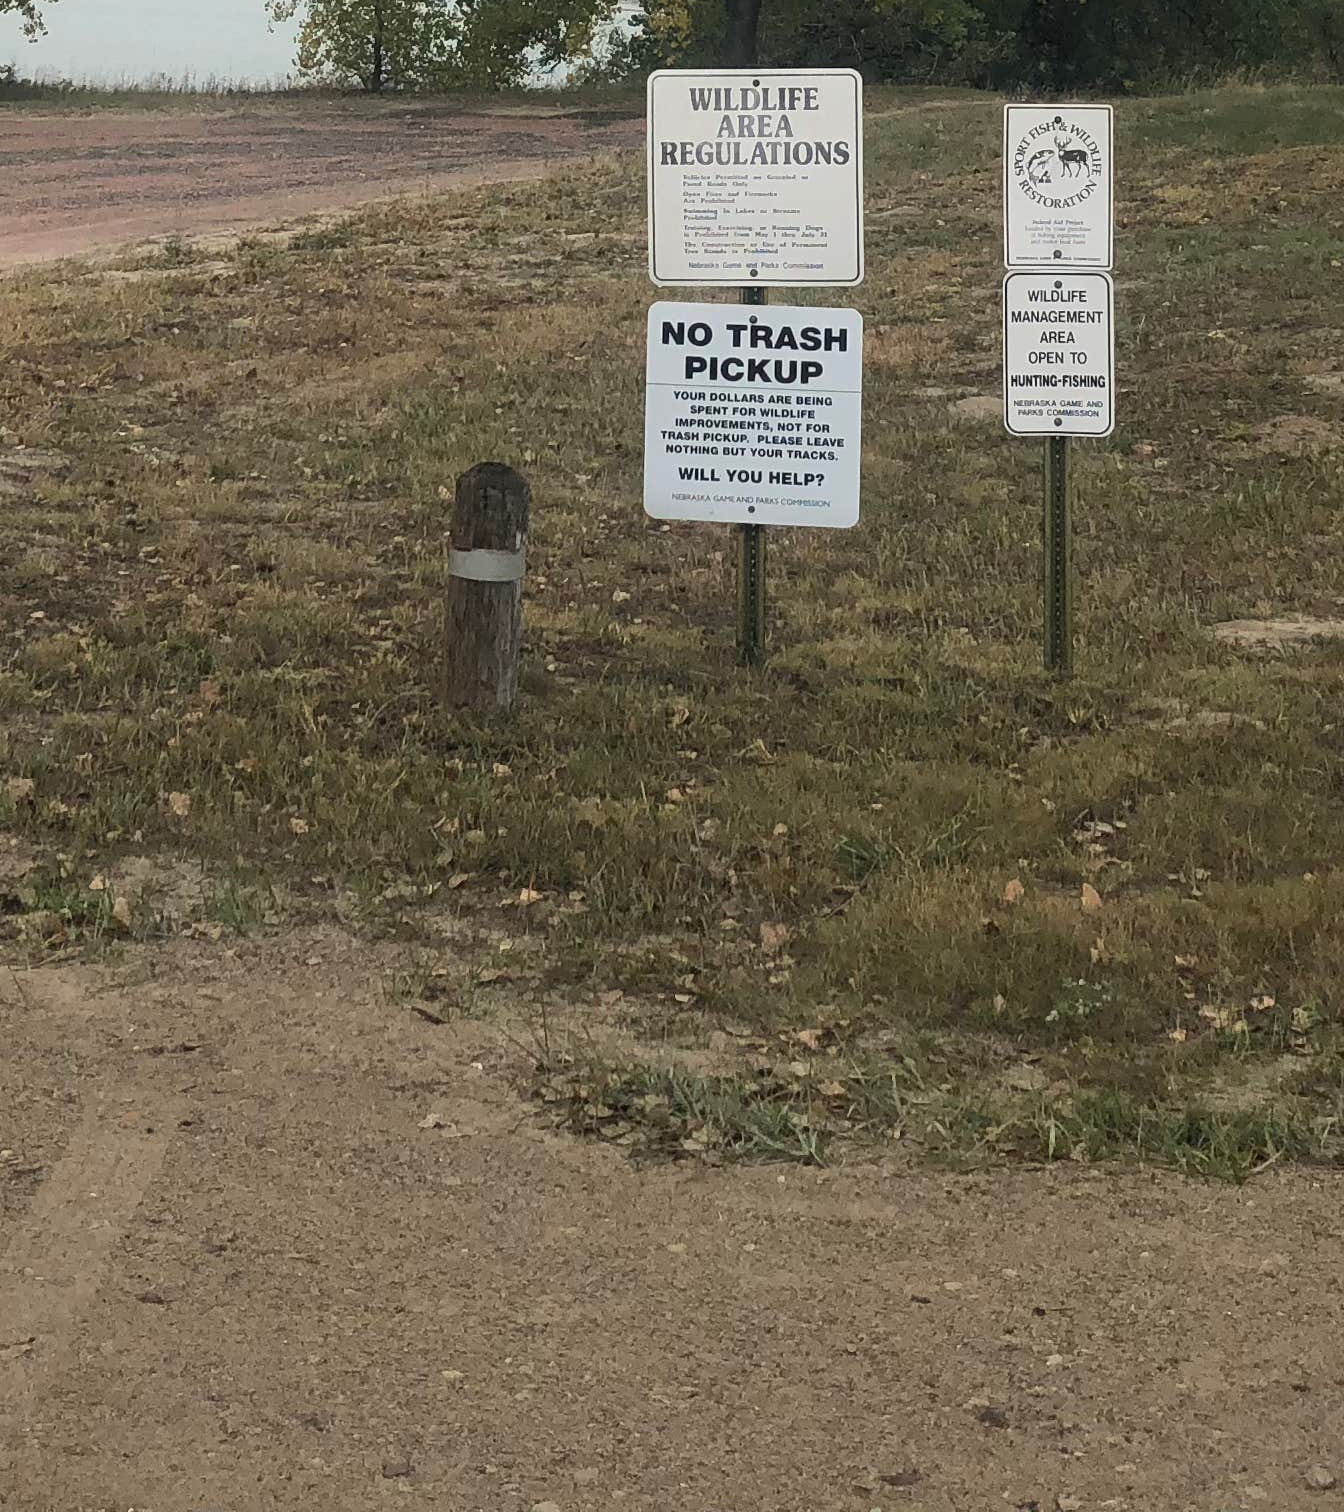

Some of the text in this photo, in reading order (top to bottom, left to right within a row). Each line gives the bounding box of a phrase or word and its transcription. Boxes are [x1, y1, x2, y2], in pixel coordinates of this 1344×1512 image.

[689, 87, 819, 111] WILDLIFE
[717, 114, 794, 138] AREA
[660, 141, 850, 166] REGULATIONS
[1015, 122, 1102, 176] SPORT FISH & WILDLIFE
[1019, 179, 1097, 208] RESTORATION
[1028, 291, 1087, 302] WILDLIFE
[1011, 311, 1103, 323] MANAGEMENT
[662, 322, 848, 351] NO TRASH
[1040, 332, 1075, 343] AREA
[1029, 352, 1087, 364] OPEN TO
[685, 356, 823, 384] PICKUP
[1011, 375, 1105, 388] HUNTING-FISHING
[674, 391, 832, 406] YOUR DOLLARS ARE BEING
[690, 406, 815, 418] SPENT FOR WILDLIFE
[675, 419, 830, 433] IMPROVEMENTS, NOT FOR
[661, 431, 844, 447] TRASH PICKUP. PLEASE LEAVE
[666, 445, 718, 455] NOTHING
[723, 447, 746, 456] BUT
[750, 448, 783, 458] YOUR
[679, 468, 824, 486] WILL YOU HELP?
